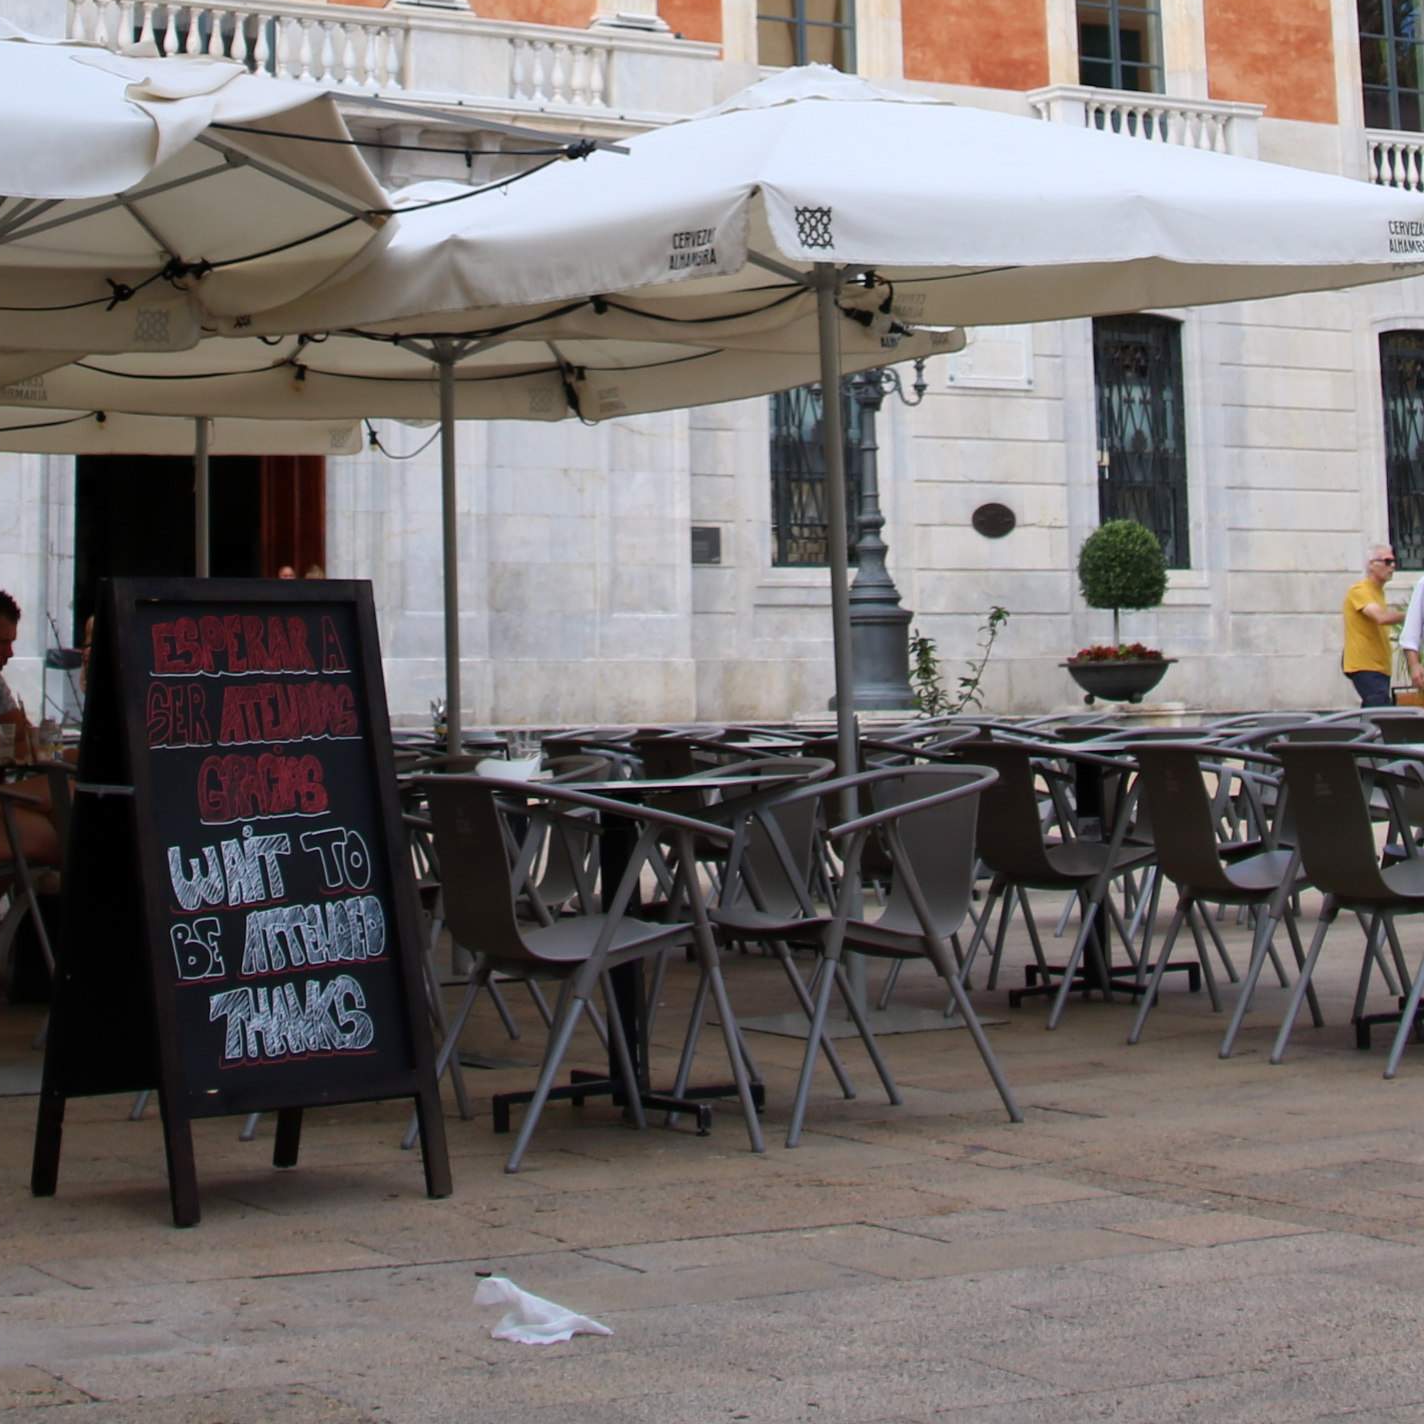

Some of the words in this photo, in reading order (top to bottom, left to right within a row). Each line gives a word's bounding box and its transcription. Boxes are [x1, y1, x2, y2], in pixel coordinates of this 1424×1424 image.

[151, 615, 315, 673] ESPERAR
[321, 616, 348, 671] A
[147, 681, 212, 747] SER
[167, 825, 291, 911] WAIT
[300, 827, 371, 889] TO
[170, 916, 226, 980] BE
[241, 895, 386, 975] ATTENDED
[209, 974, 374, 1060] THANKS
